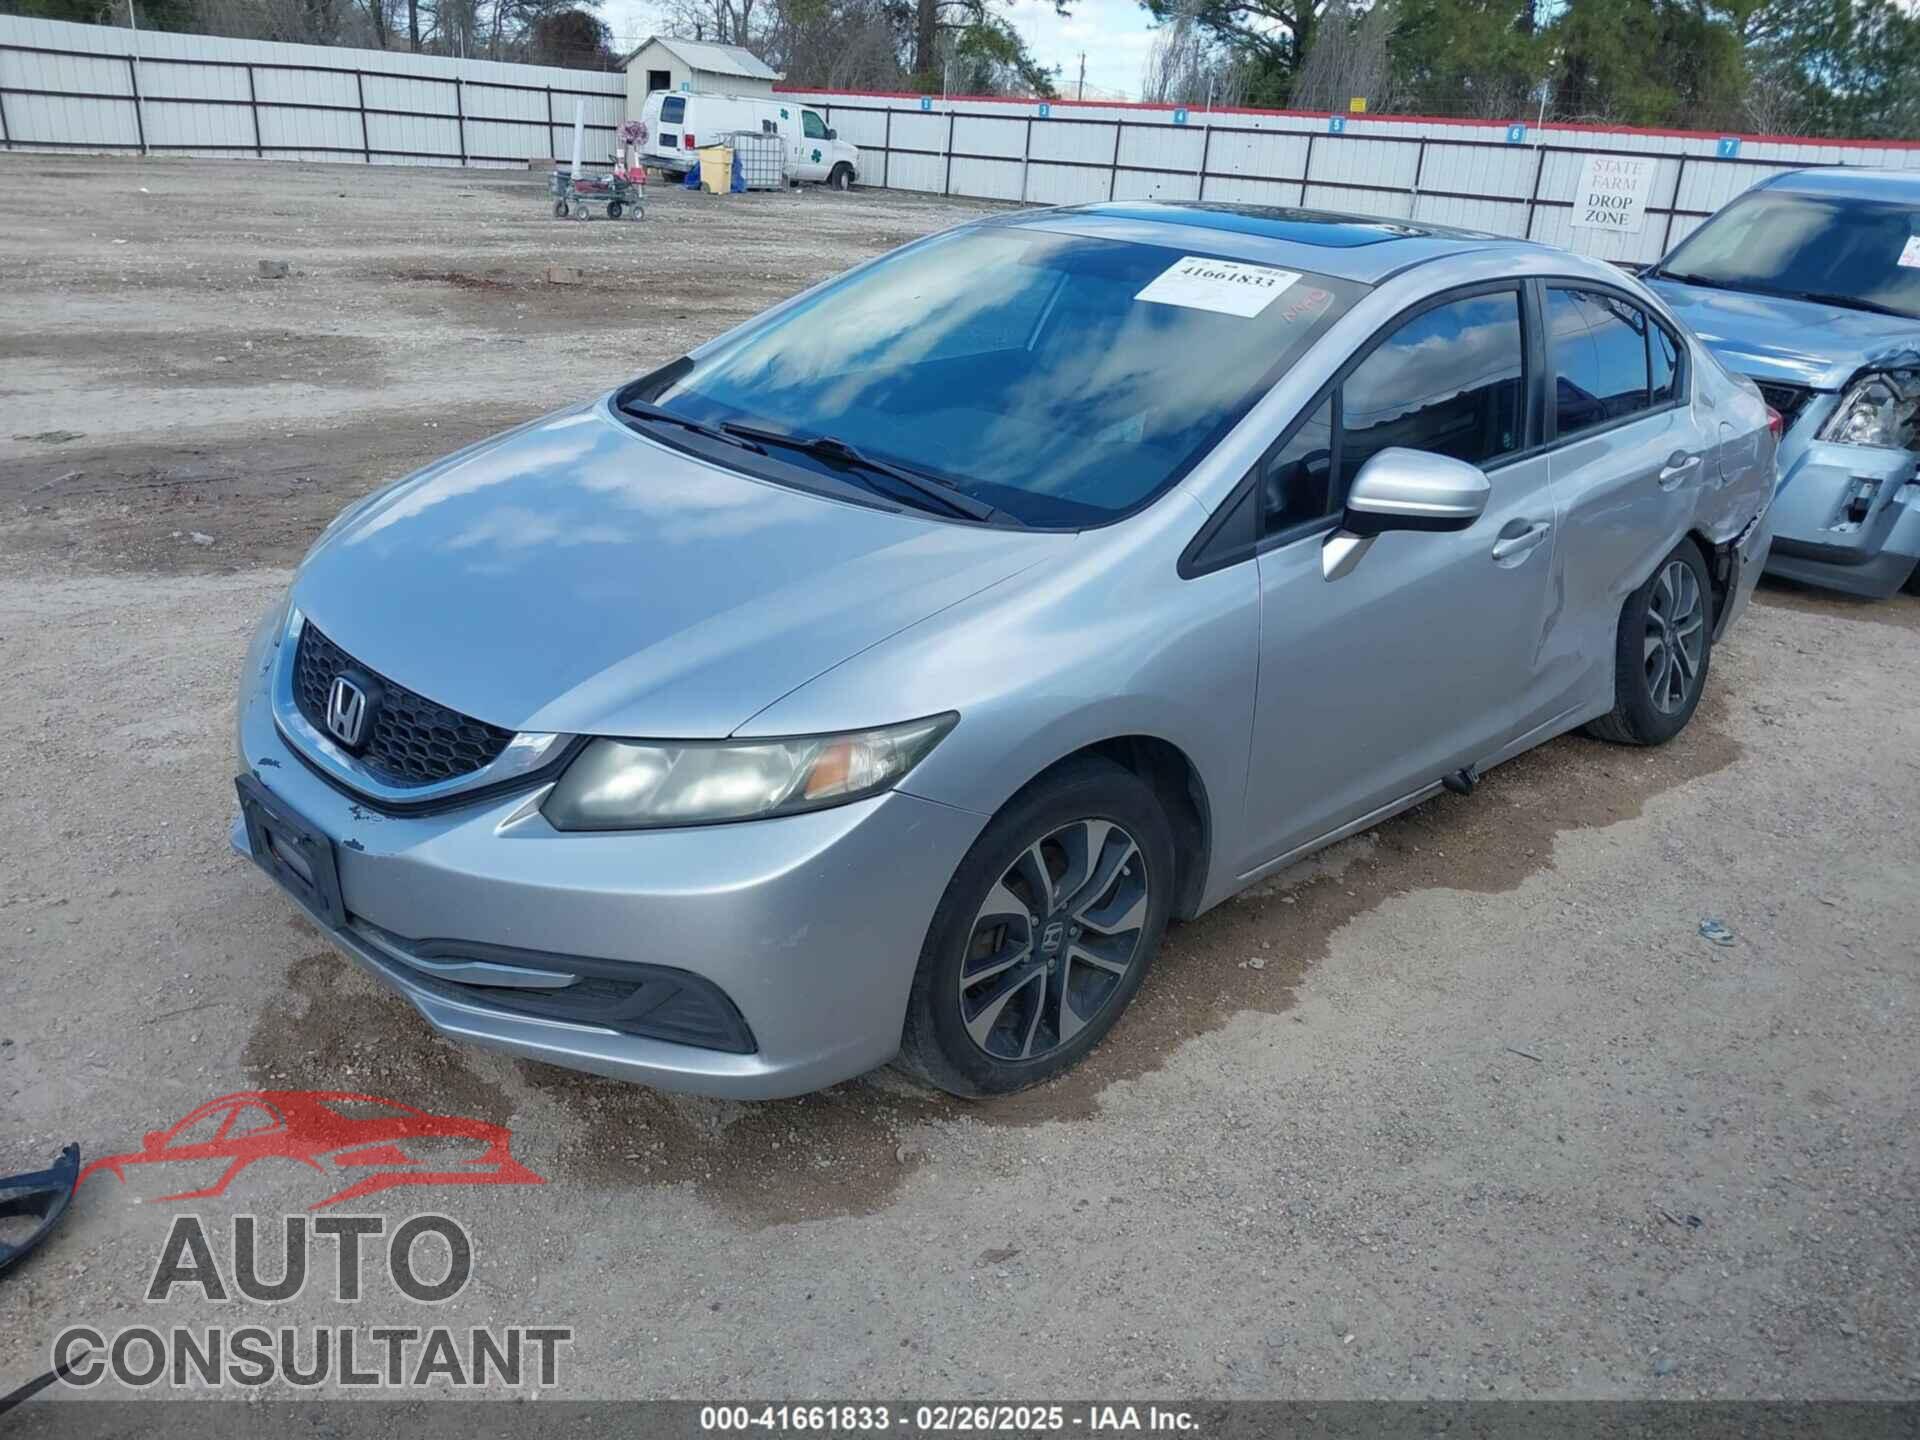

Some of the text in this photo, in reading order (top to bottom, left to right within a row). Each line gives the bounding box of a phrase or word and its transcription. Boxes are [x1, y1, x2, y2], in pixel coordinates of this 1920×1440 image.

[1592, 159, 1646, 175] STATE
[1591, 175, 1638, 191] FARM
[1587, 193, 1633, 210] DROP
[1584, 208, 1631, 225] ZONE
